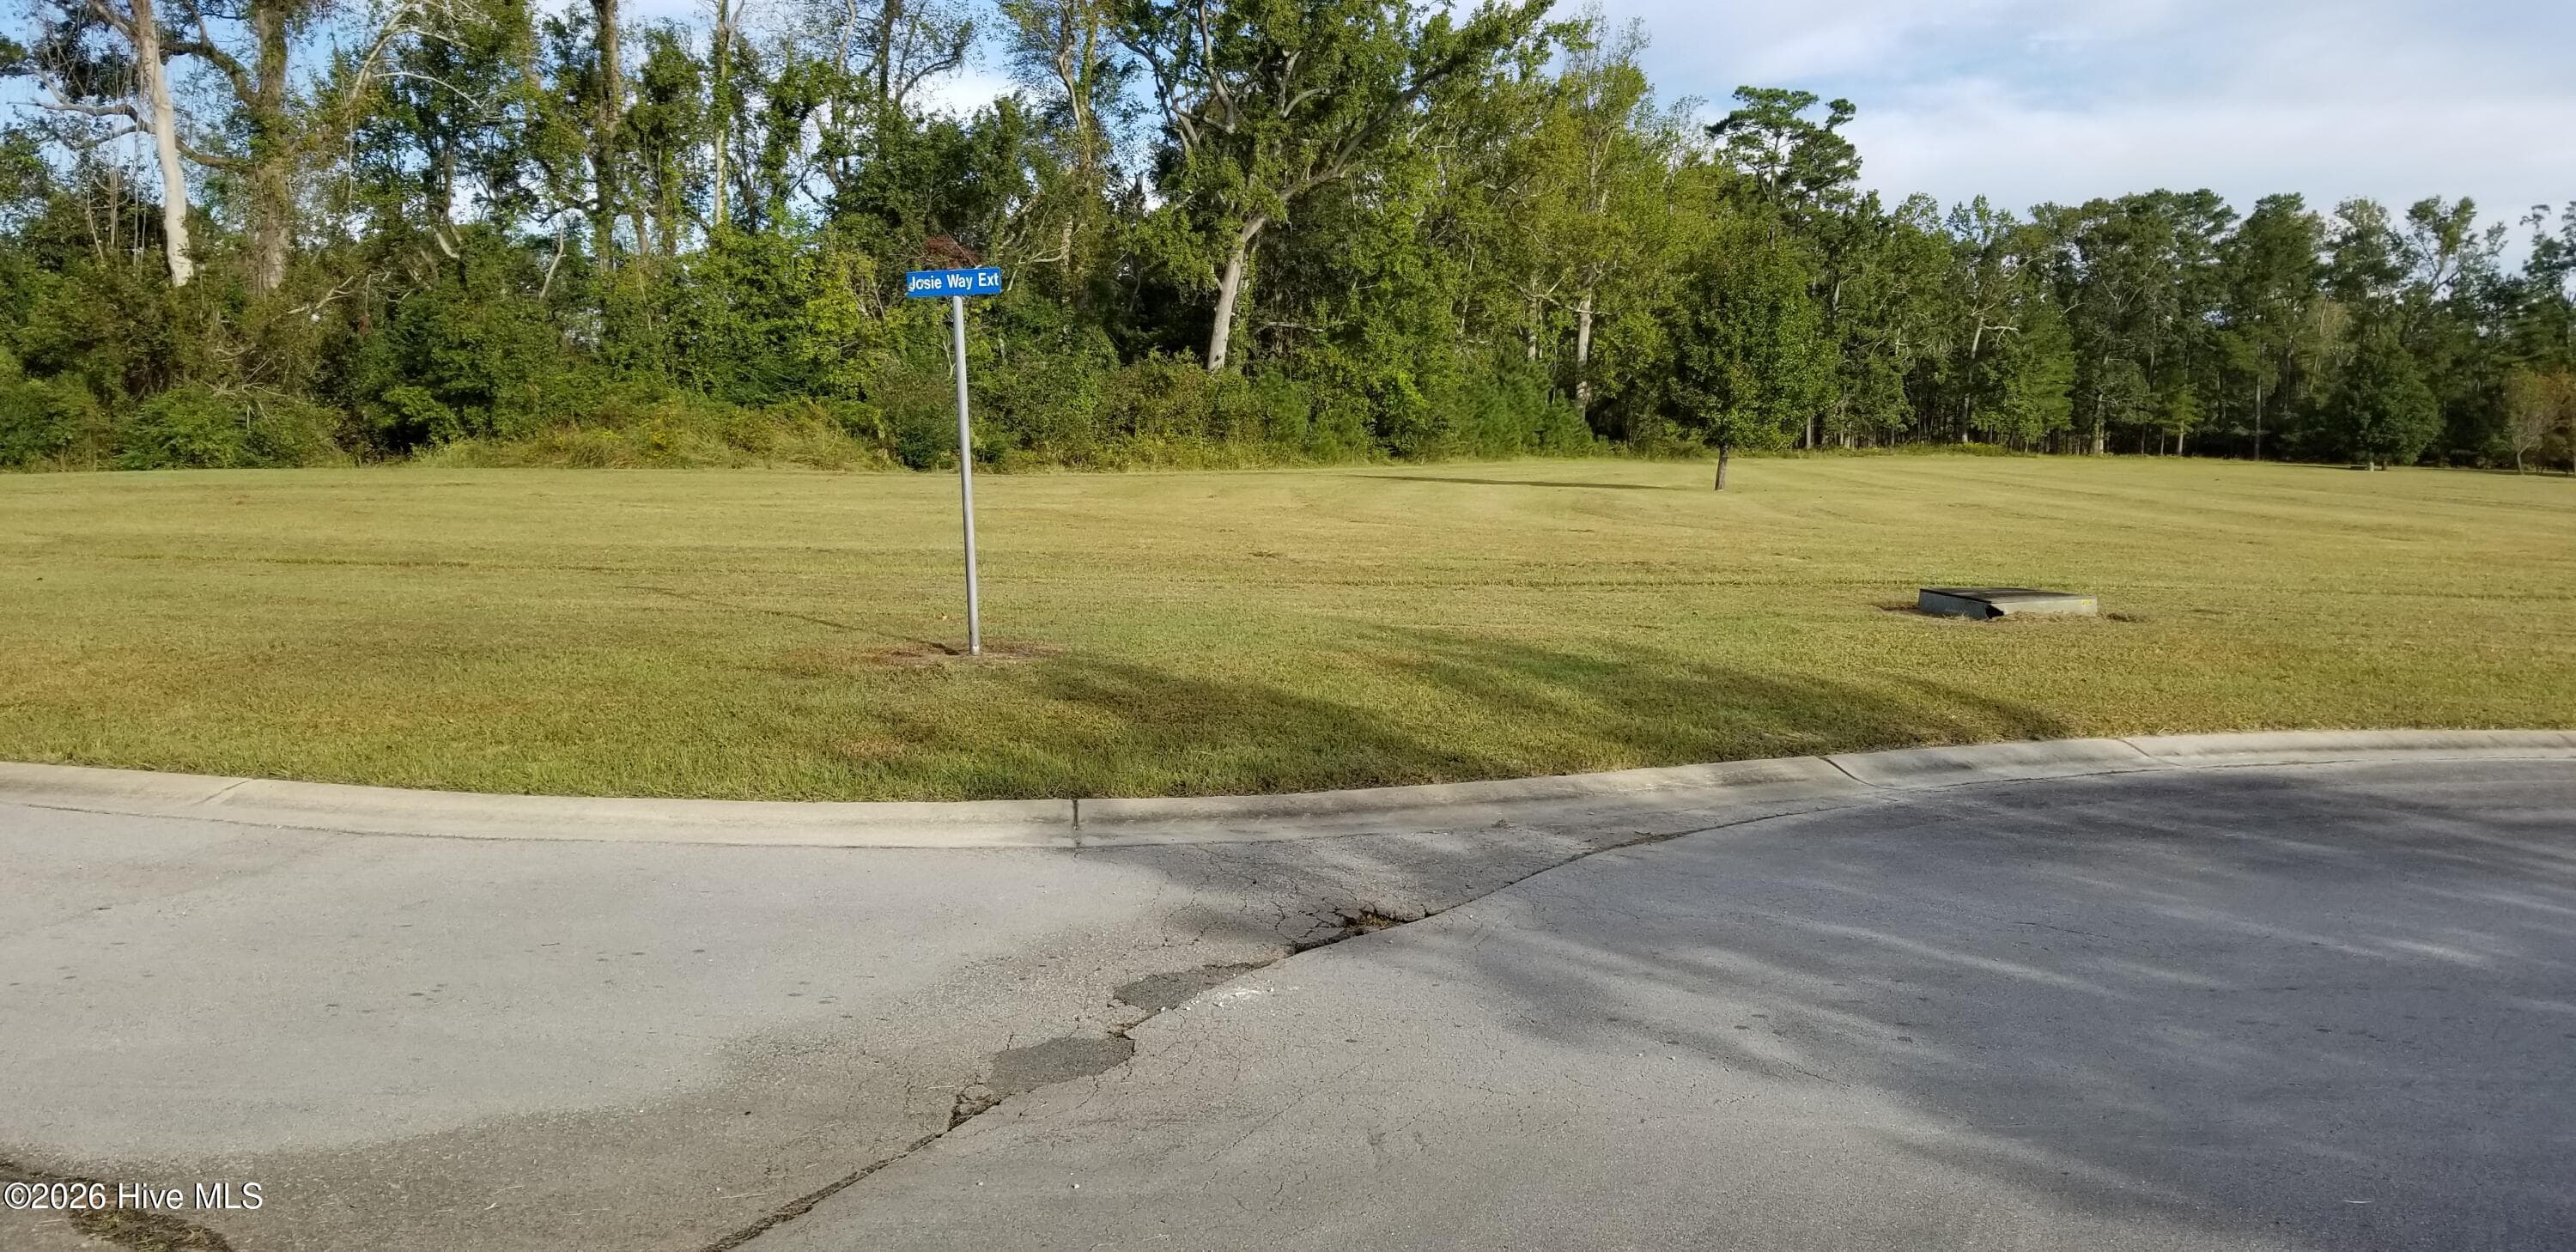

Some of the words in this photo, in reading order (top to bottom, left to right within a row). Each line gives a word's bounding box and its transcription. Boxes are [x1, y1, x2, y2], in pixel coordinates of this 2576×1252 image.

[908, 275, 942, 292] Josie
[946, 273, 973, 290] Way
[978, 272, 999, 287] Ext
